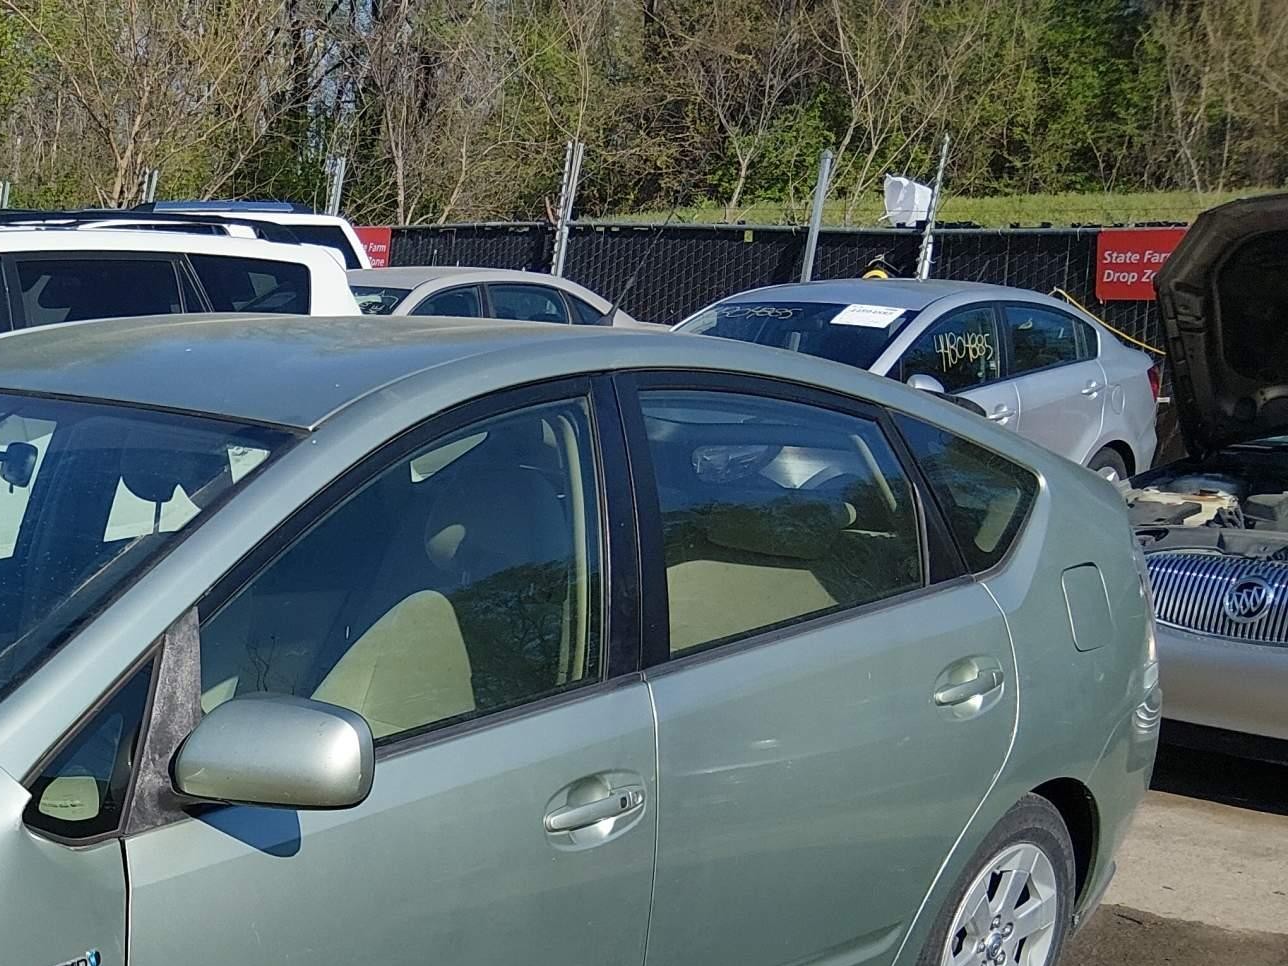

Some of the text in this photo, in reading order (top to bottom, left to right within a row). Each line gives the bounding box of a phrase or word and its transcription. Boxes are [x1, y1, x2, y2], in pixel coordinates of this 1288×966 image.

[368, 243, 387, 252] Farm
[369, 256, 385, 267] one
[1103, 250, 1140, 263] State
[1103, 269, 1138, 285] Drop
